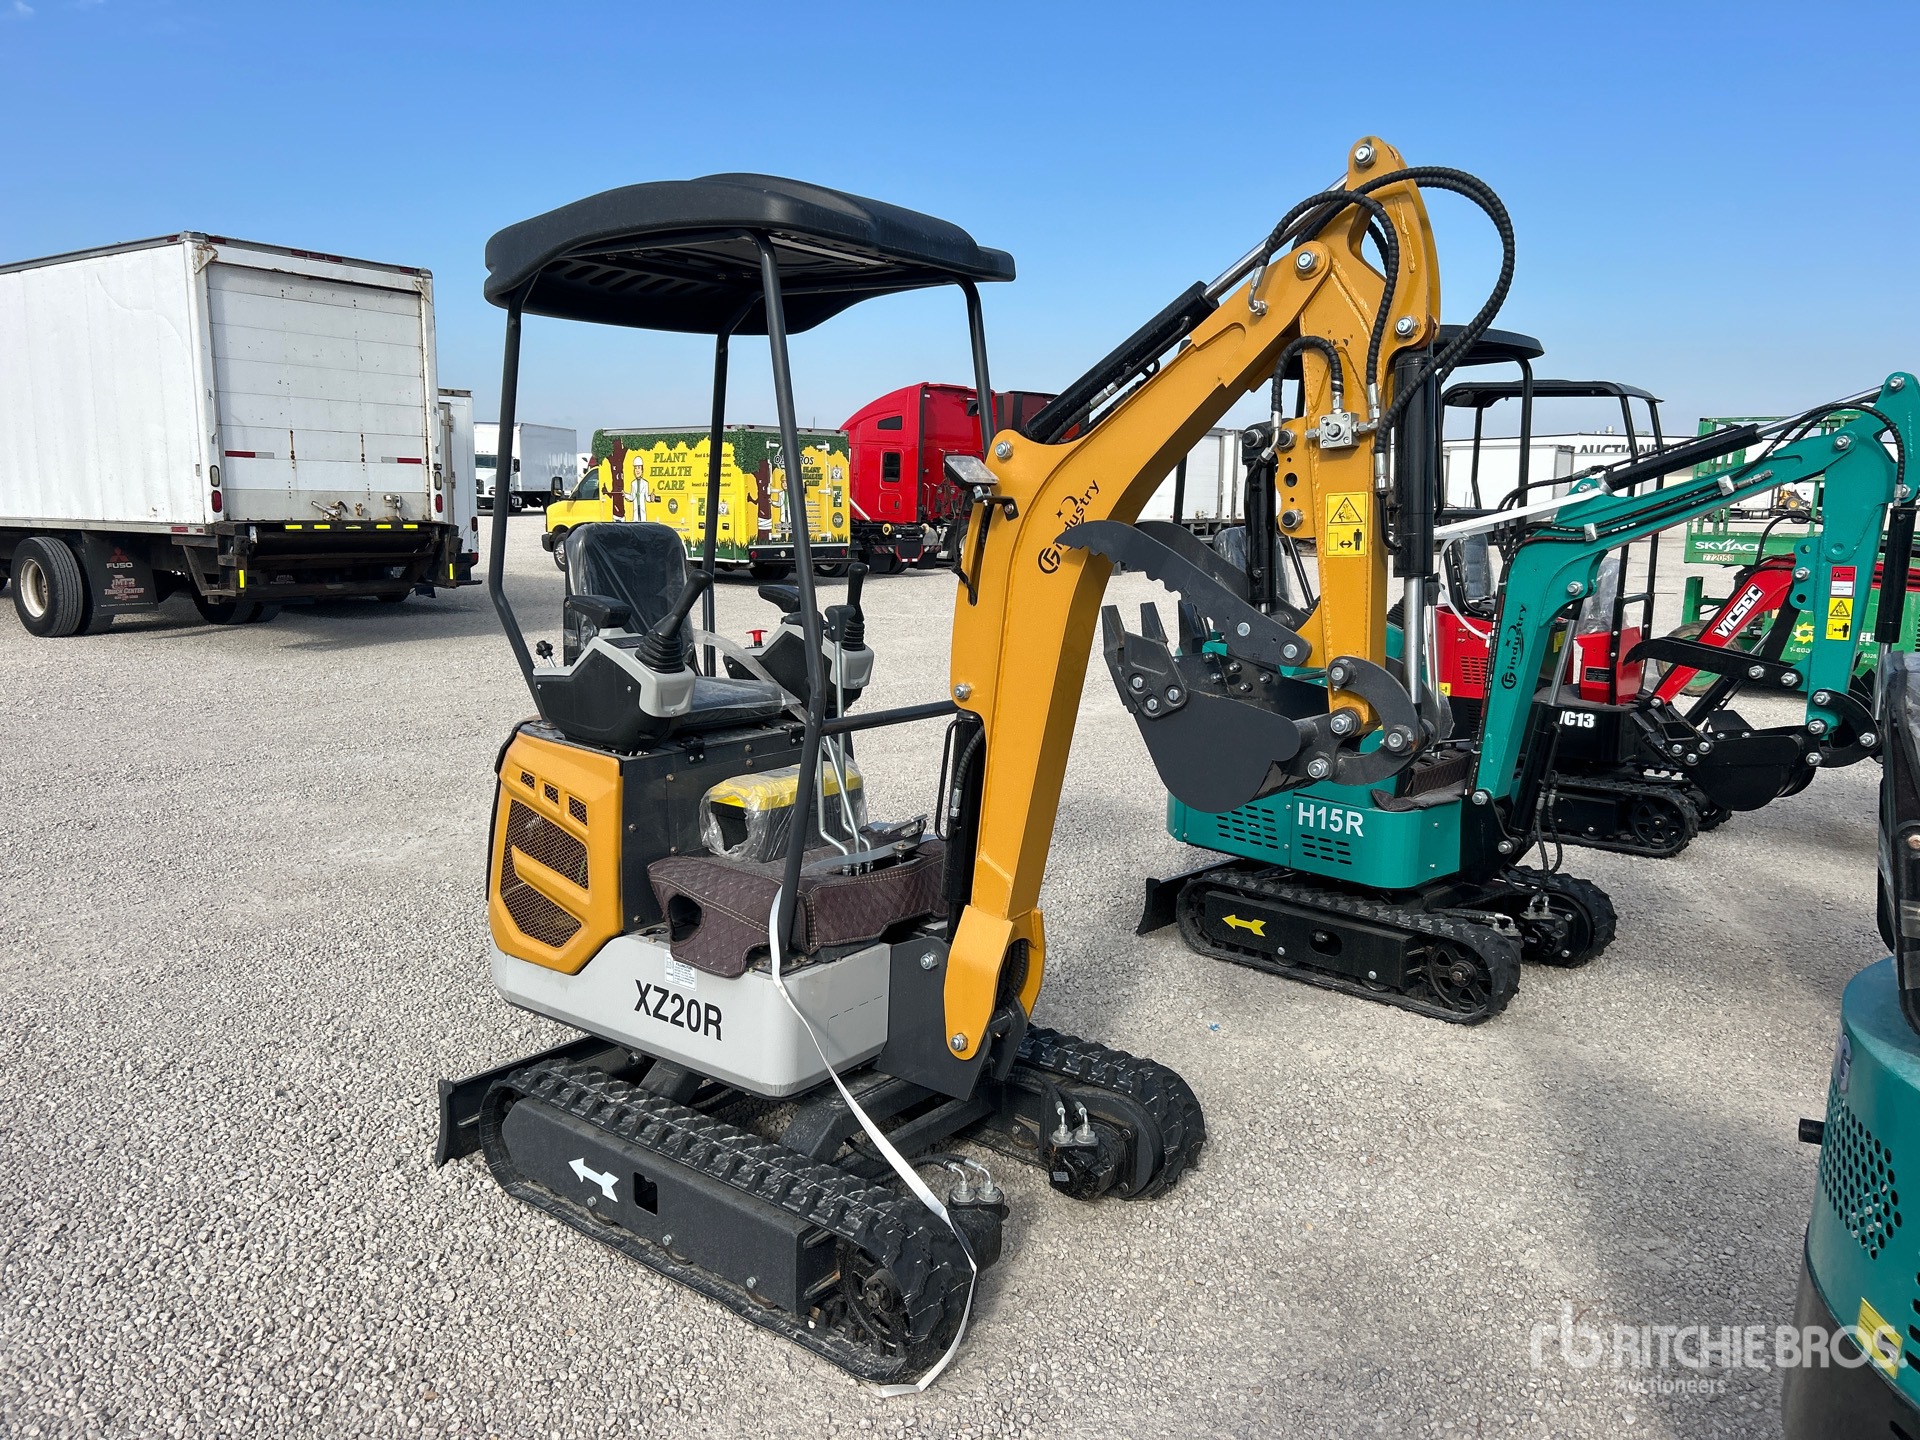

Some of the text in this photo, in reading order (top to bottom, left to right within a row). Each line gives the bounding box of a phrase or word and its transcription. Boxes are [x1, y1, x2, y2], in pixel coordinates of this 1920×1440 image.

[653, 452, 688, 463] PLANT
[650, 466, 692, 477] HEALTH
[657, 480, 685, 491] CARE
[1713, 585, 1763, 637] VICSEC
[1298, 802, 1364, 837] H15R
[634, 979, 722, 1041] XZ20R
